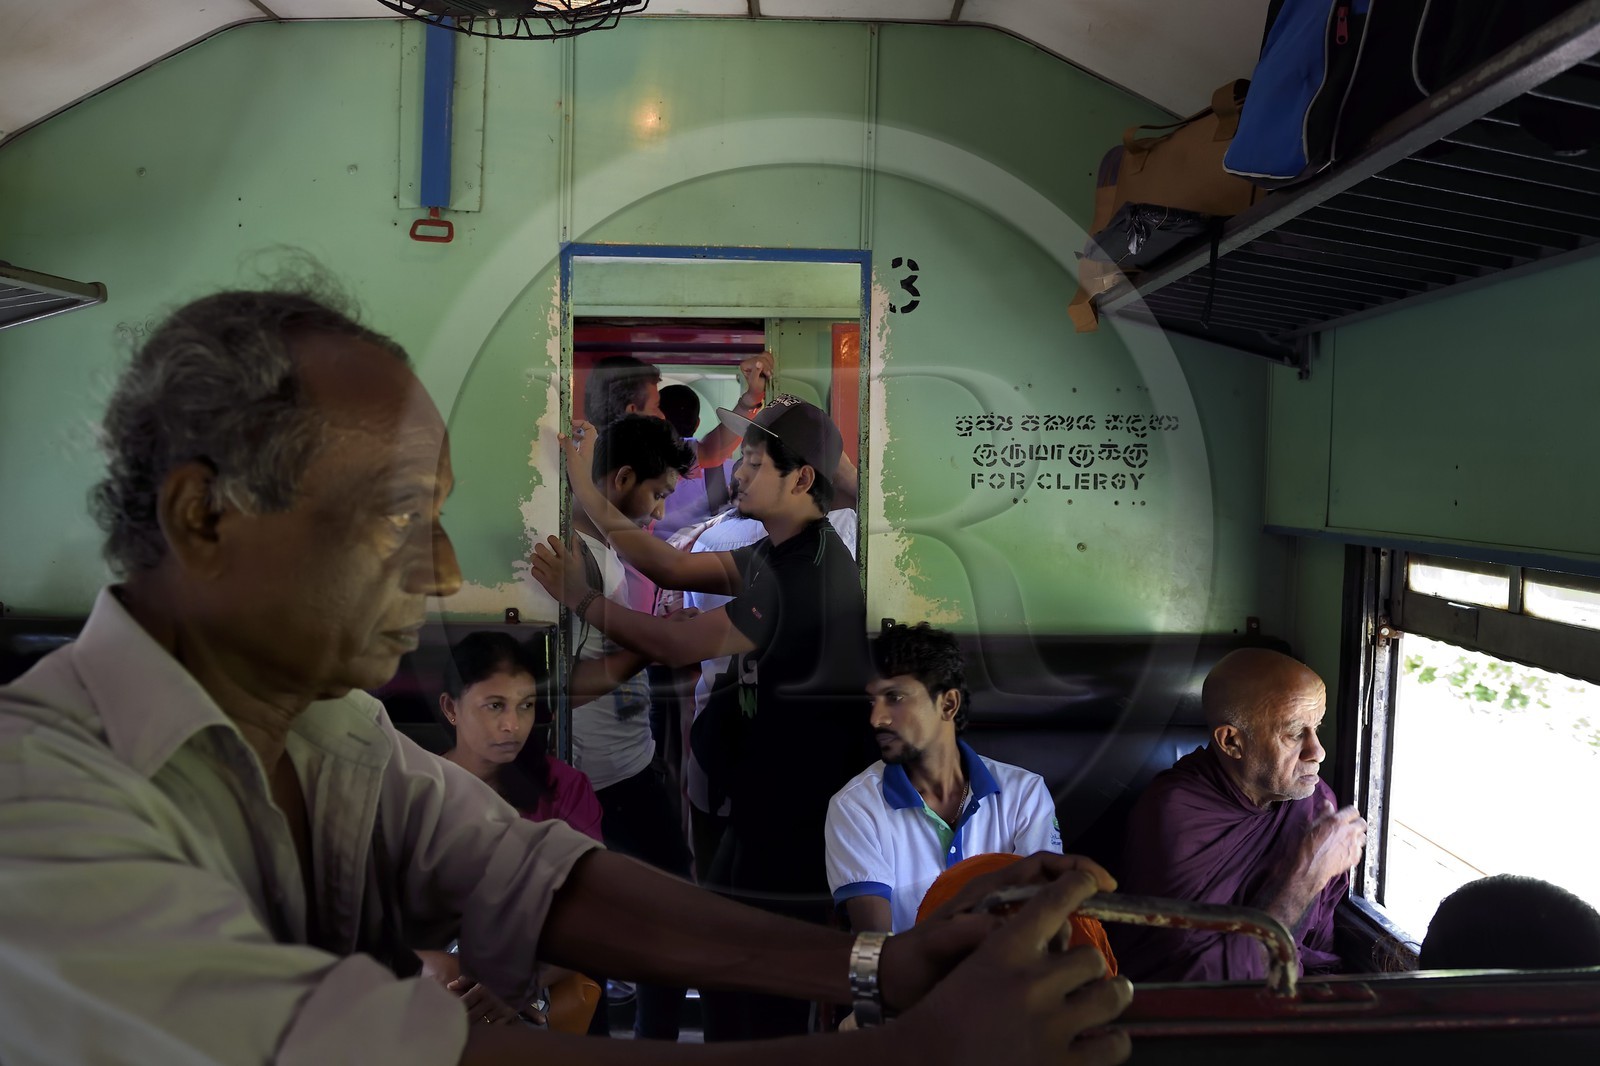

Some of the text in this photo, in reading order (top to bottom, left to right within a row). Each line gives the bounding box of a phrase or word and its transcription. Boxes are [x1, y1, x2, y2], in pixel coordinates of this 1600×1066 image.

[889, 257, 920, 314] 3
[970, 472, 1146, 491] FOR CLERGY
